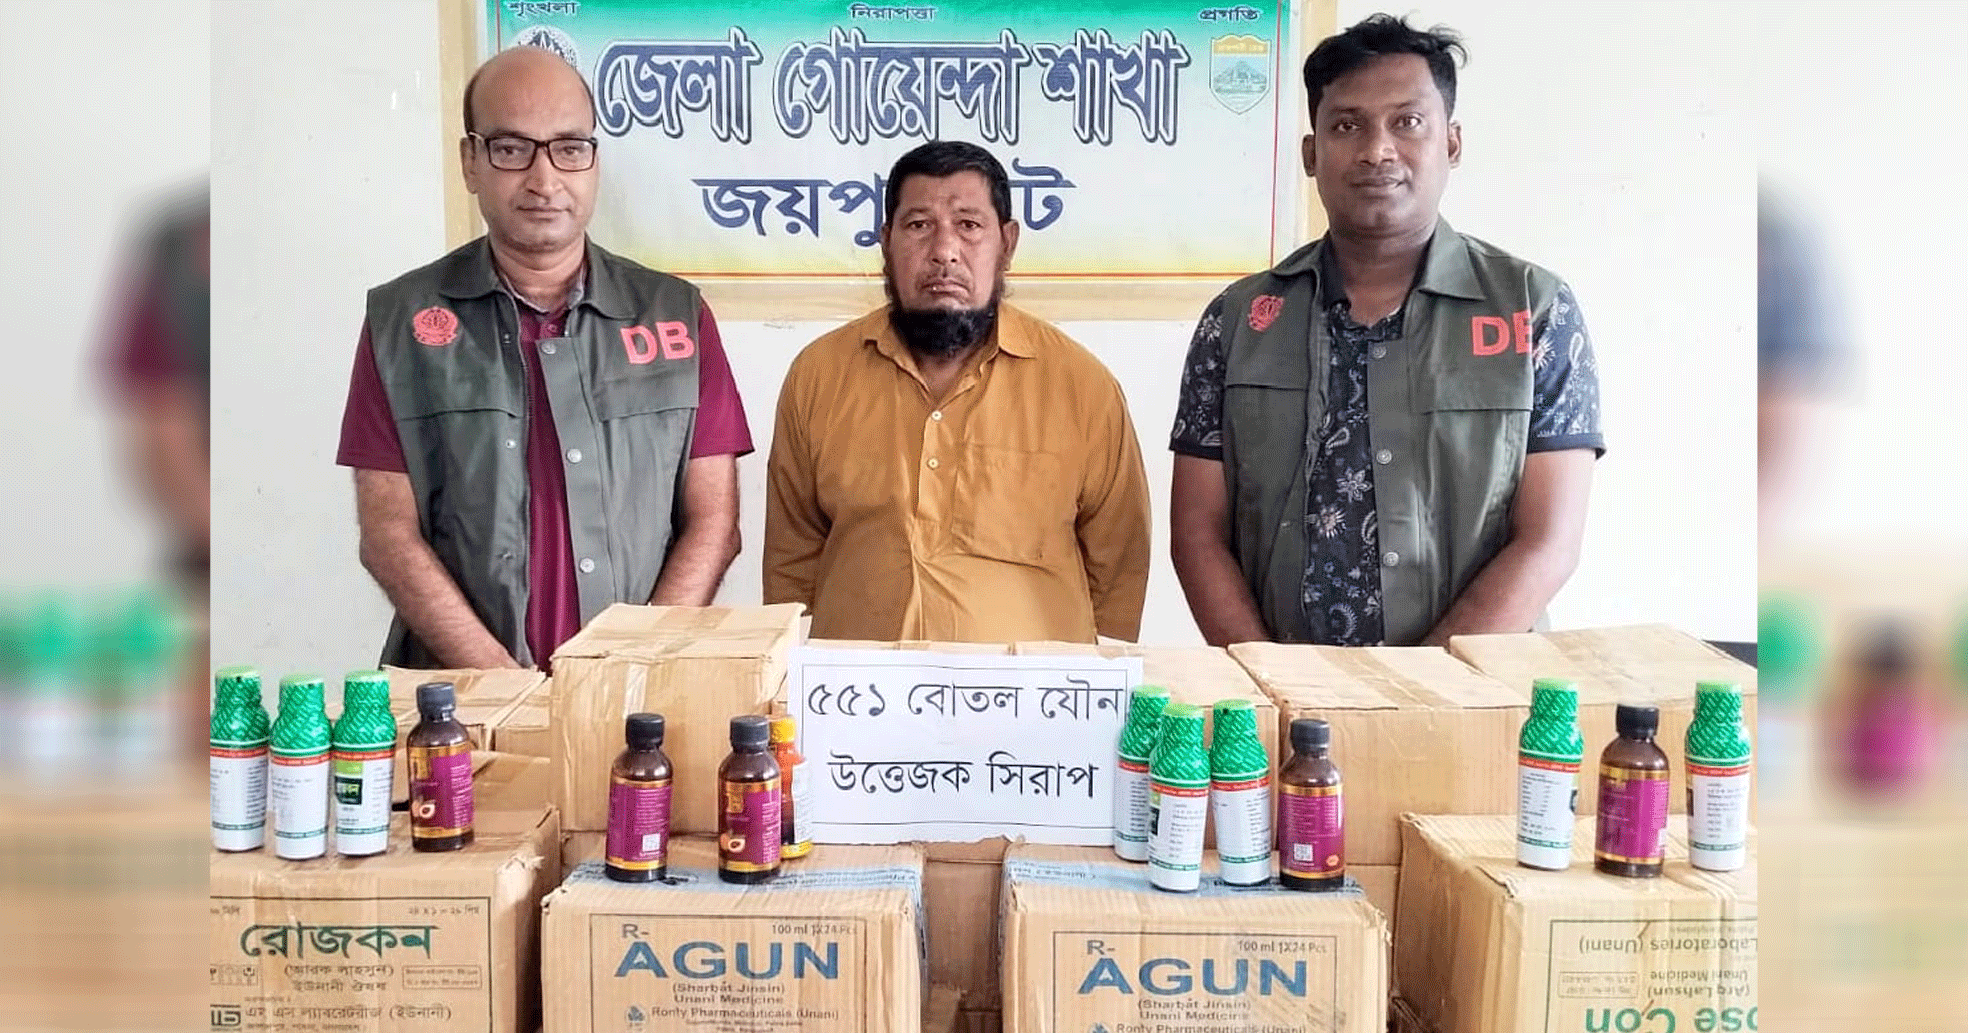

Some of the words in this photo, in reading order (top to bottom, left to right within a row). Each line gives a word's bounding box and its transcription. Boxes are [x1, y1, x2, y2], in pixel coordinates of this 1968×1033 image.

[849, 3, 937, 20] নিরাপত্তা
[1200, 5, 1261, 20] প্রগতি
[594, 26, 763, 144] জেলা
[773, 26, 1031, 145] গোয়েন্দা
[1032, 28, 1190, 145] শাখা
[620, 321, 695, 364] DB
[808, 684, 886, 716] ৫৫১
[908, 682, 1024, 718] বোতল
[1037, 674, 1124, 720] যৌন
[827, 750, 973, 793] উত্তেজক
[986, 751, 1099, 798] সিরাপ
[240, 920, 441, 959] রোজকন
[772, 924, 789, 935] 100
[794, 923, 807, 935] ml
[614, 940, 838, 980] AGUN
[1238, 941, 1258, 952] 100
[1261, 941, 1274, 952] ml
[1077, 957, 1307, 997] AGUN
[1650, 970, 1709, 982] Medicine
[719, 994, 784, 1004] Medicine
[1586, 1007, 1676, 1033] Con
